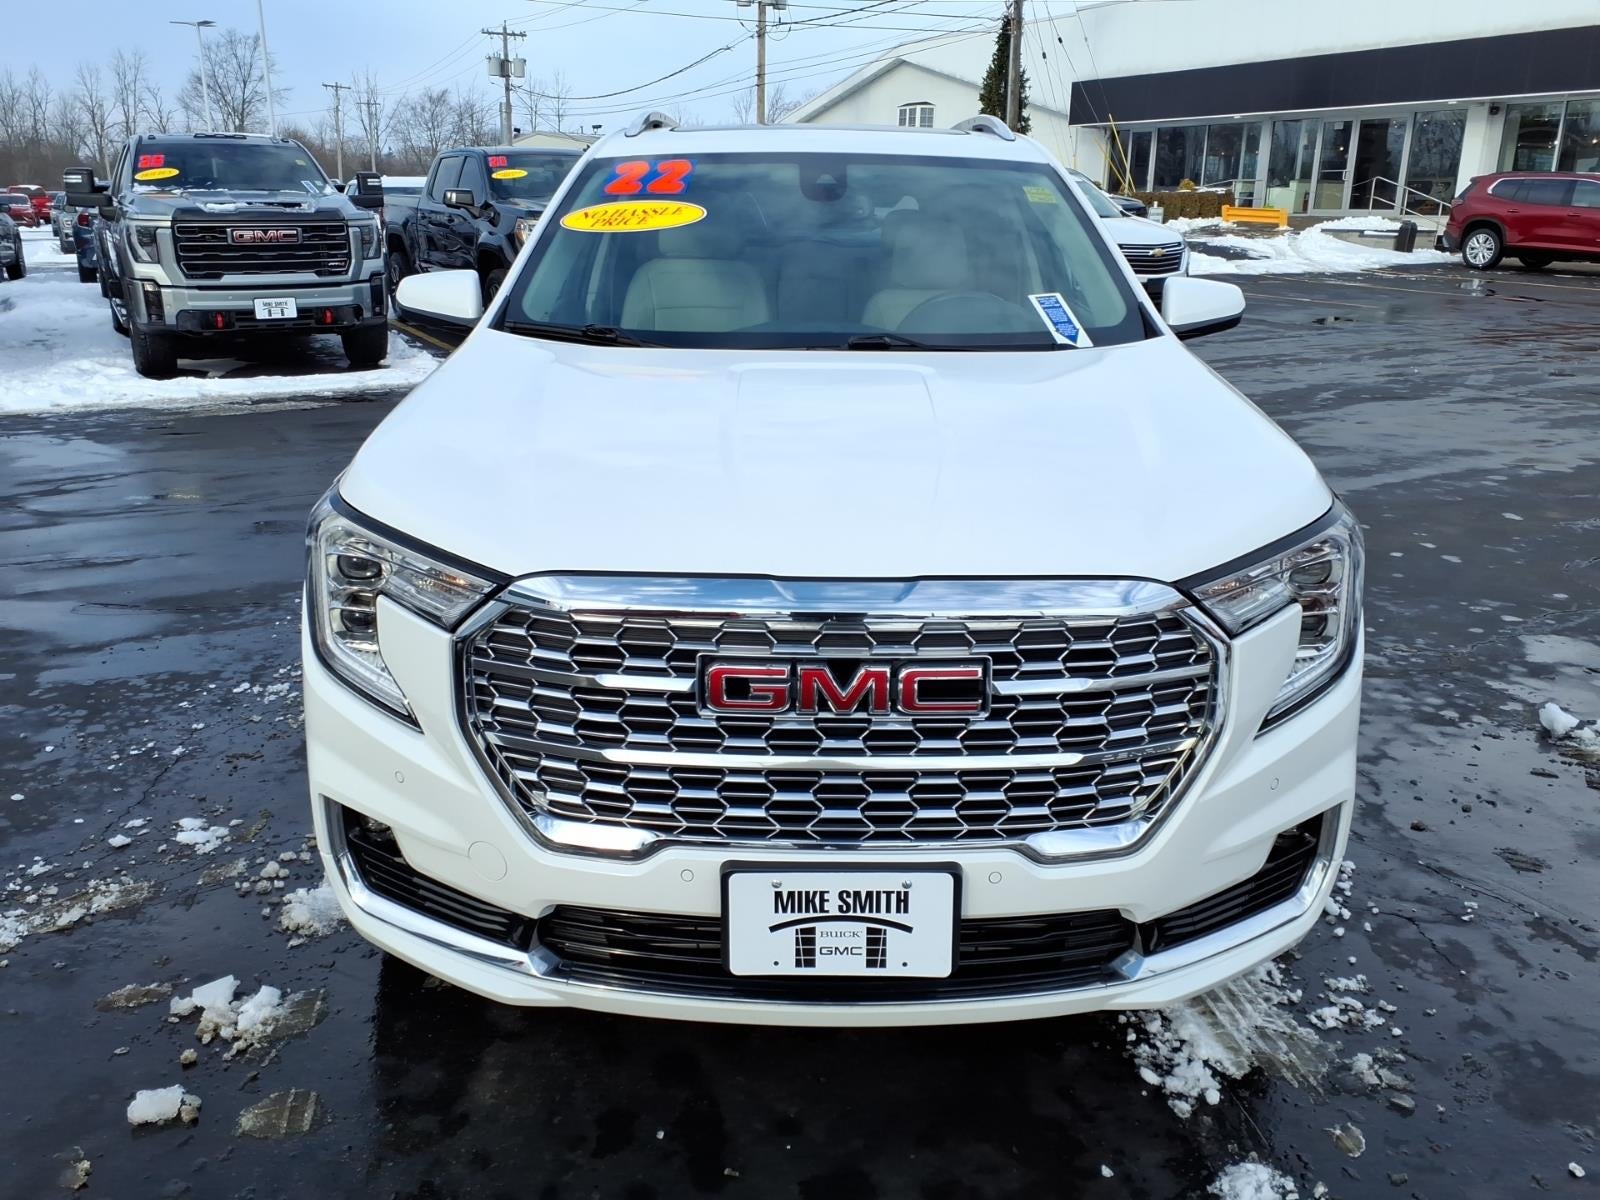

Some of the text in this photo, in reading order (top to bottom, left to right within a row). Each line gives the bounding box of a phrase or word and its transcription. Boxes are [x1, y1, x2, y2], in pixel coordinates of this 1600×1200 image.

[604, 159, 692, 195] 22
[582, 205, 684, 219] NO HASSLE
[590, 215, 648, 227] PRICE
[233, 230, 297, 243] GMC
[705, 663, 982, 715] GMC
[774, 890, 909, 914] MIKE SMITH
[820, 930, 862, 938] BUICK
[819, 946, 863, 956] GMC
